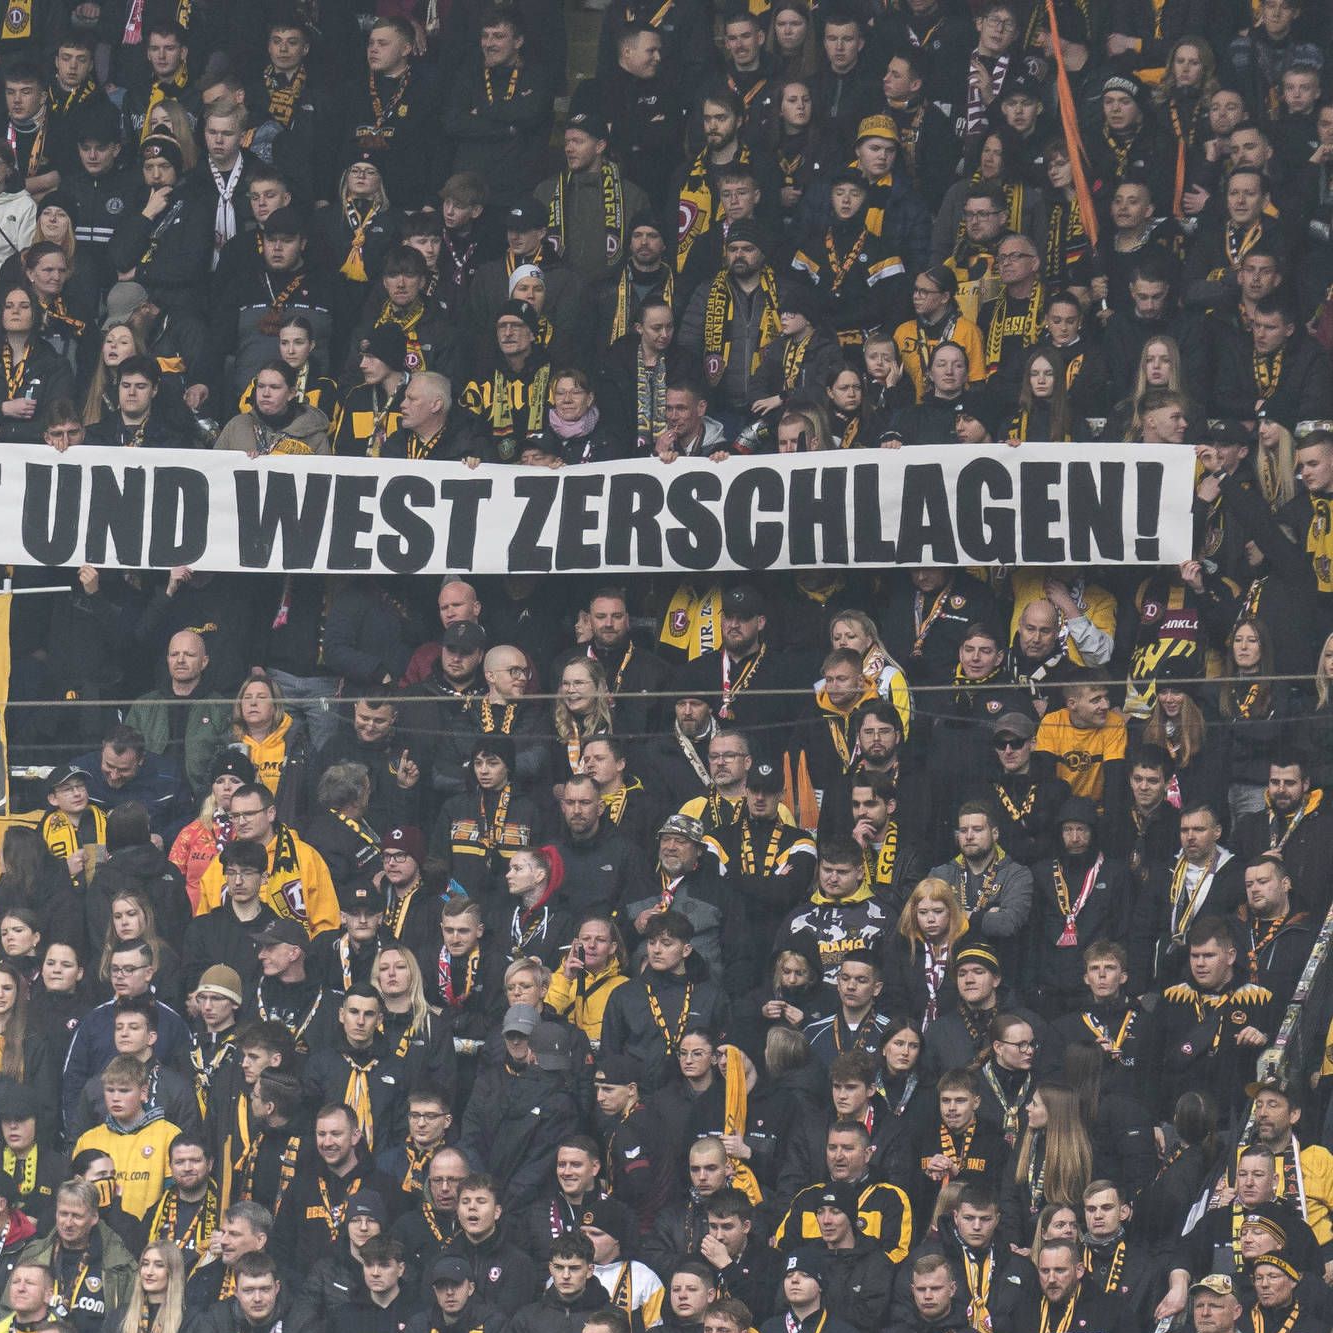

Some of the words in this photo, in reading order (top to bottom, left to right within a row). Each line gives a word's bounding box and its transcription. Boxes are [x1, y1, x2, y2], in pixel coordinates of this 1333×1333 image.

[21, 463, 210, 568] UND
[234, 471, 493, 573] WEST
[507, 460, 1164, 573] ZERSCHLAGEN!
